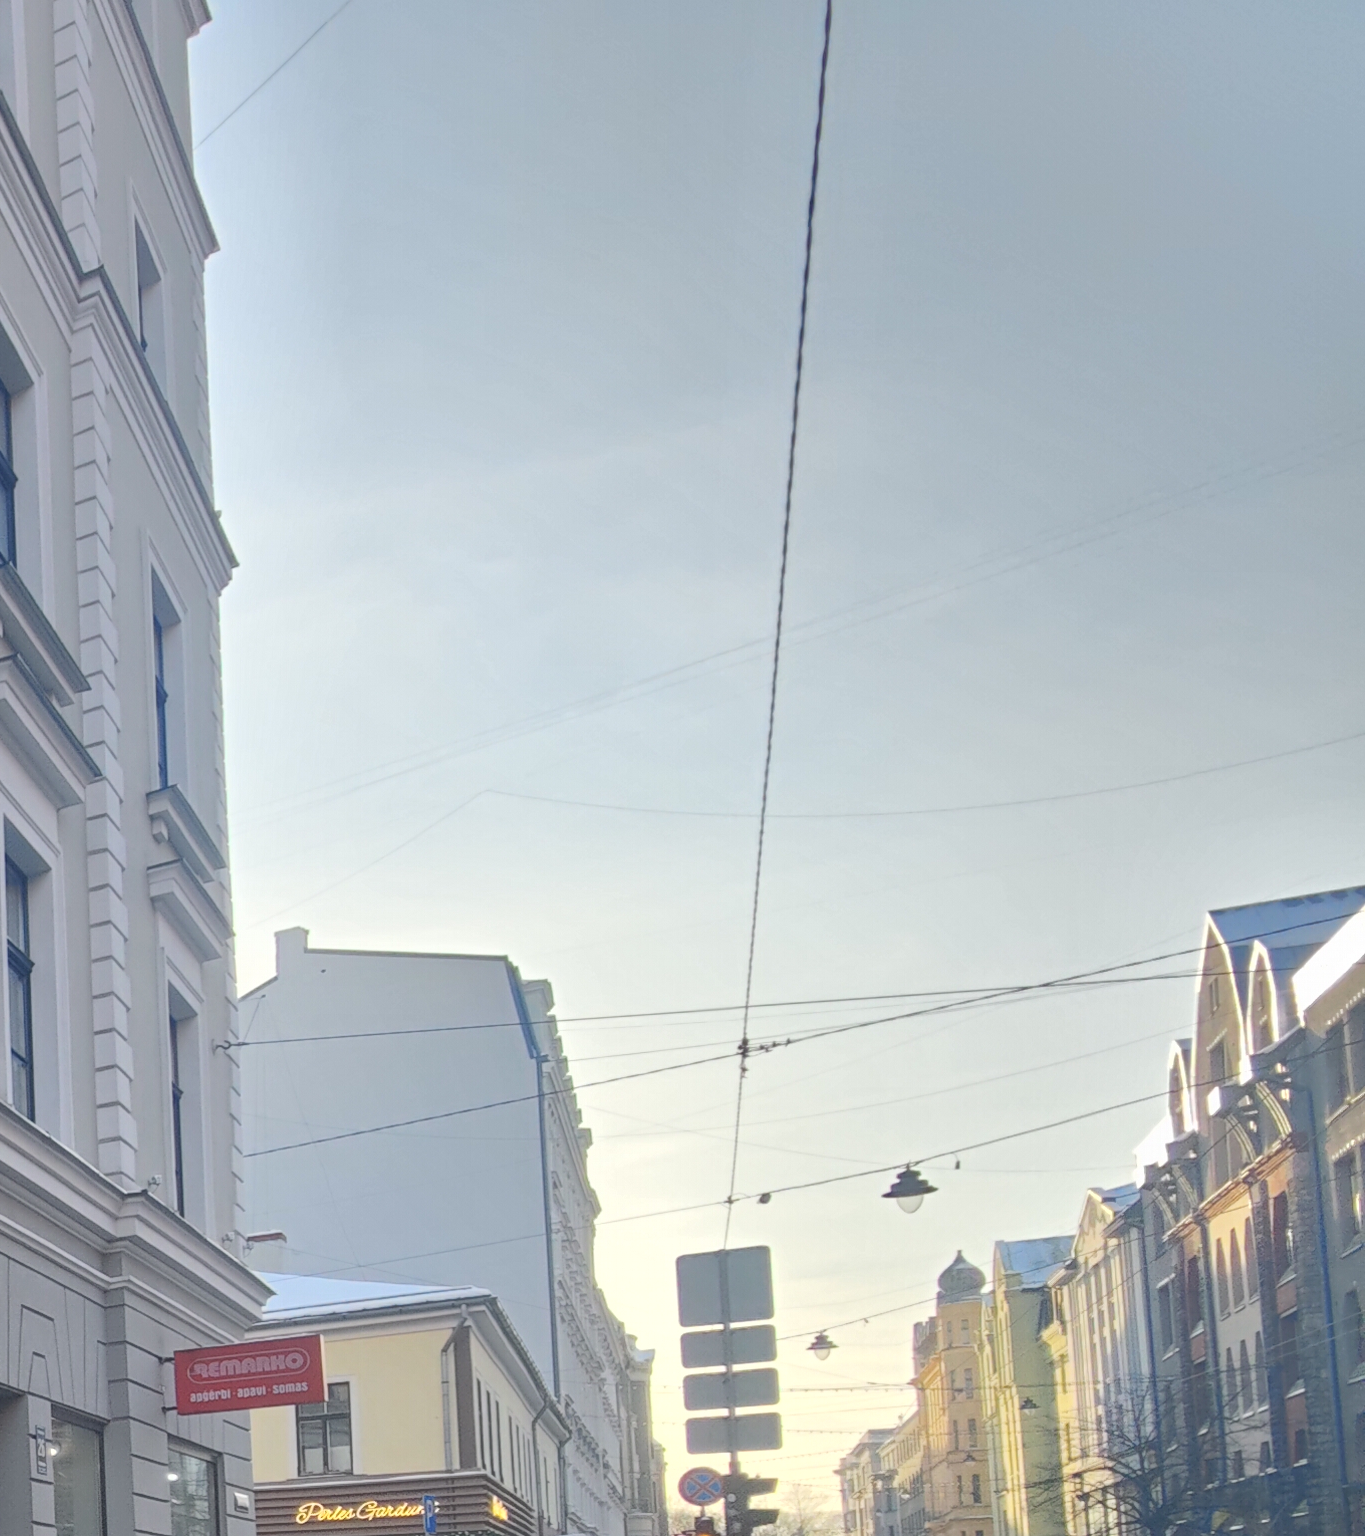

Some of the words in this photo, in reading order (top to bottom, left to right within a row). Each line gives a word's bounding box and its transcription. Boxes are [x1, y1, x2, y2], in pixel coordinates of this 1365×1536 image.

[190, 1352, 305, 1378] REMARKO
[237, 1385, 267, 1398] apavi
[272, 1381, 309, 1394] somas
